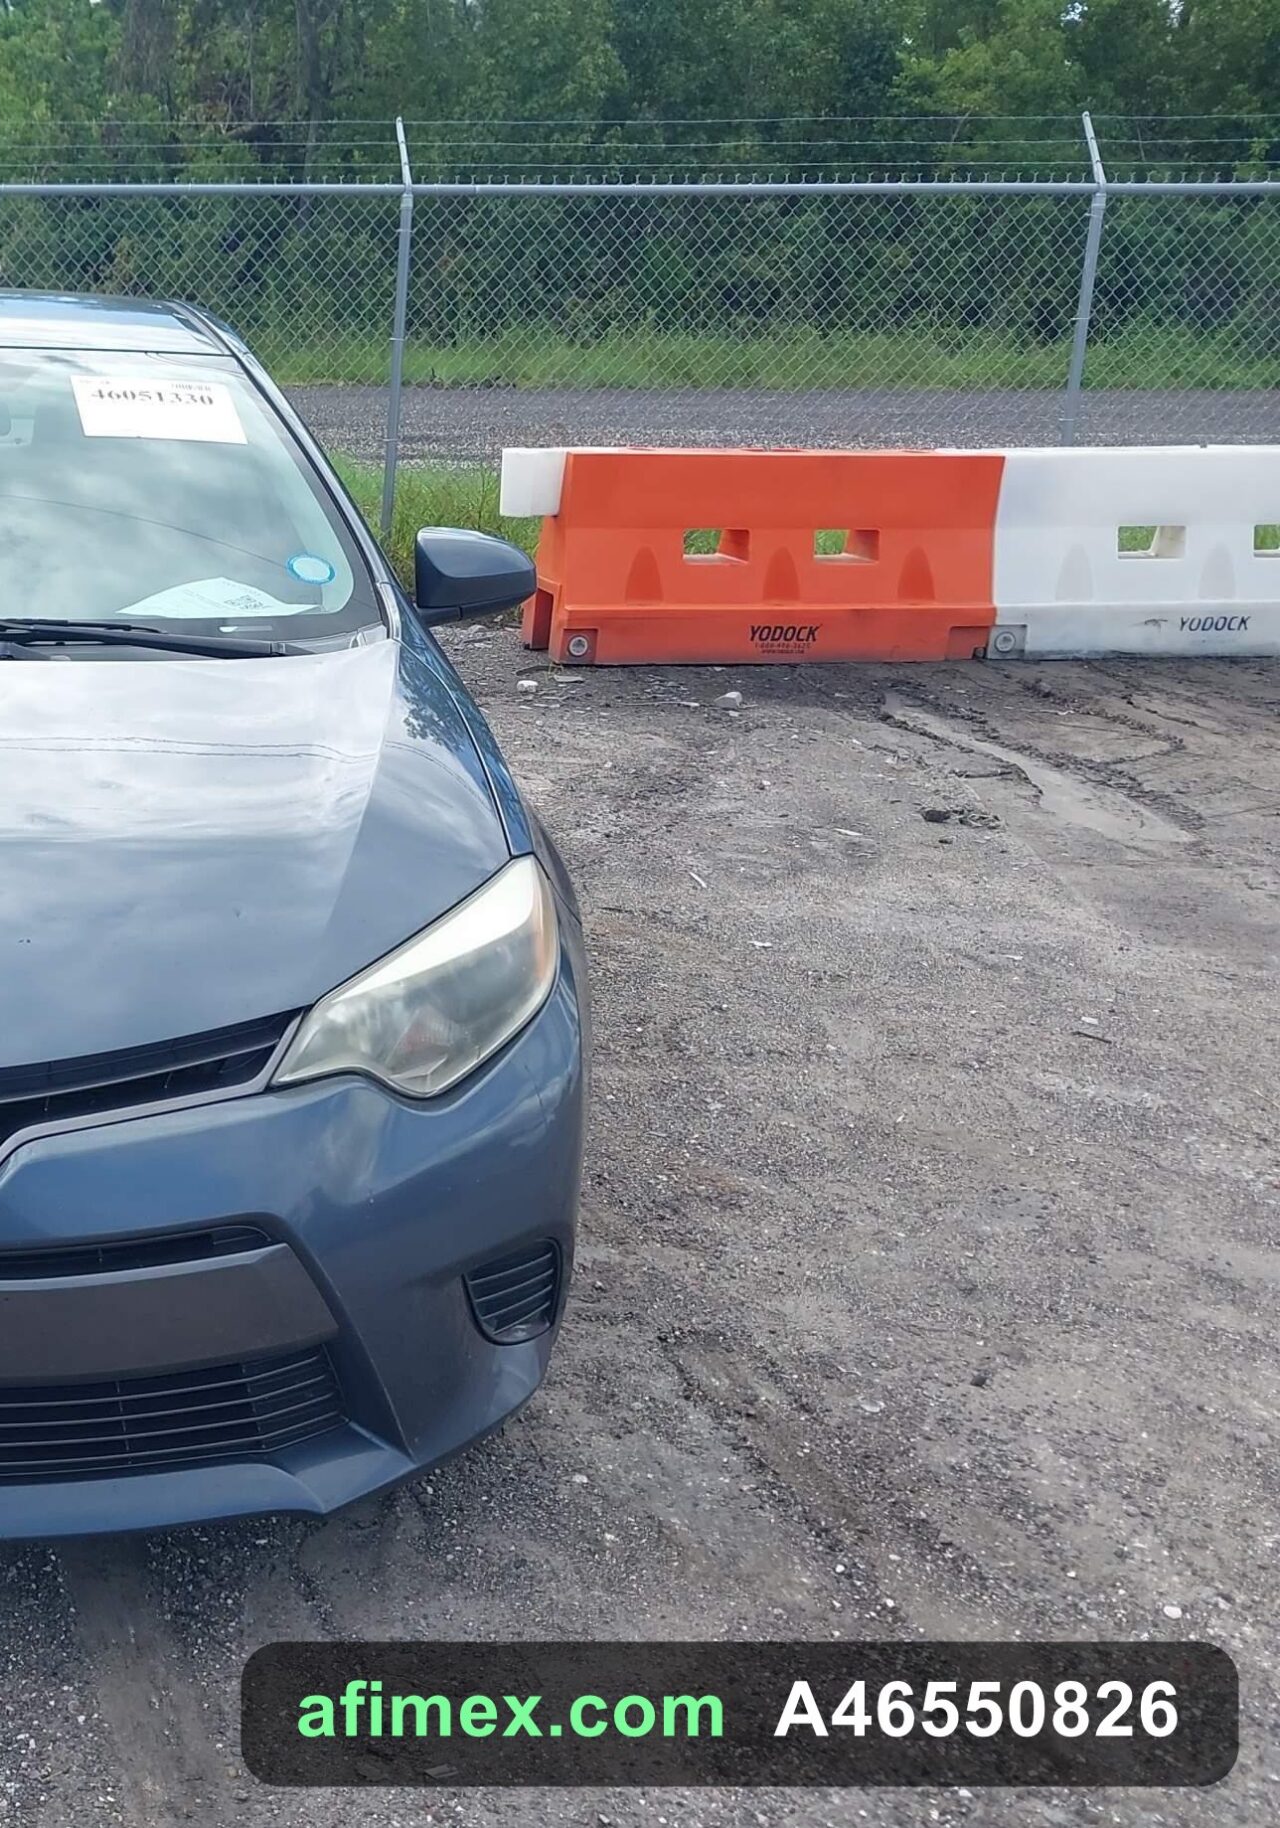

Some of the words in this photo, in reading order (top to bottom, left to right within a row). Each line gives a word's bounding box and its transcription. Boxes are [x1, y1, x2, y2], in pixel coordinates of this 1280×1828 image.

[91, 388, 214, 406] 46051330
[1179, 615, 1251, 632] YODOCK
[750, 624, 822, 642] YODOCK
